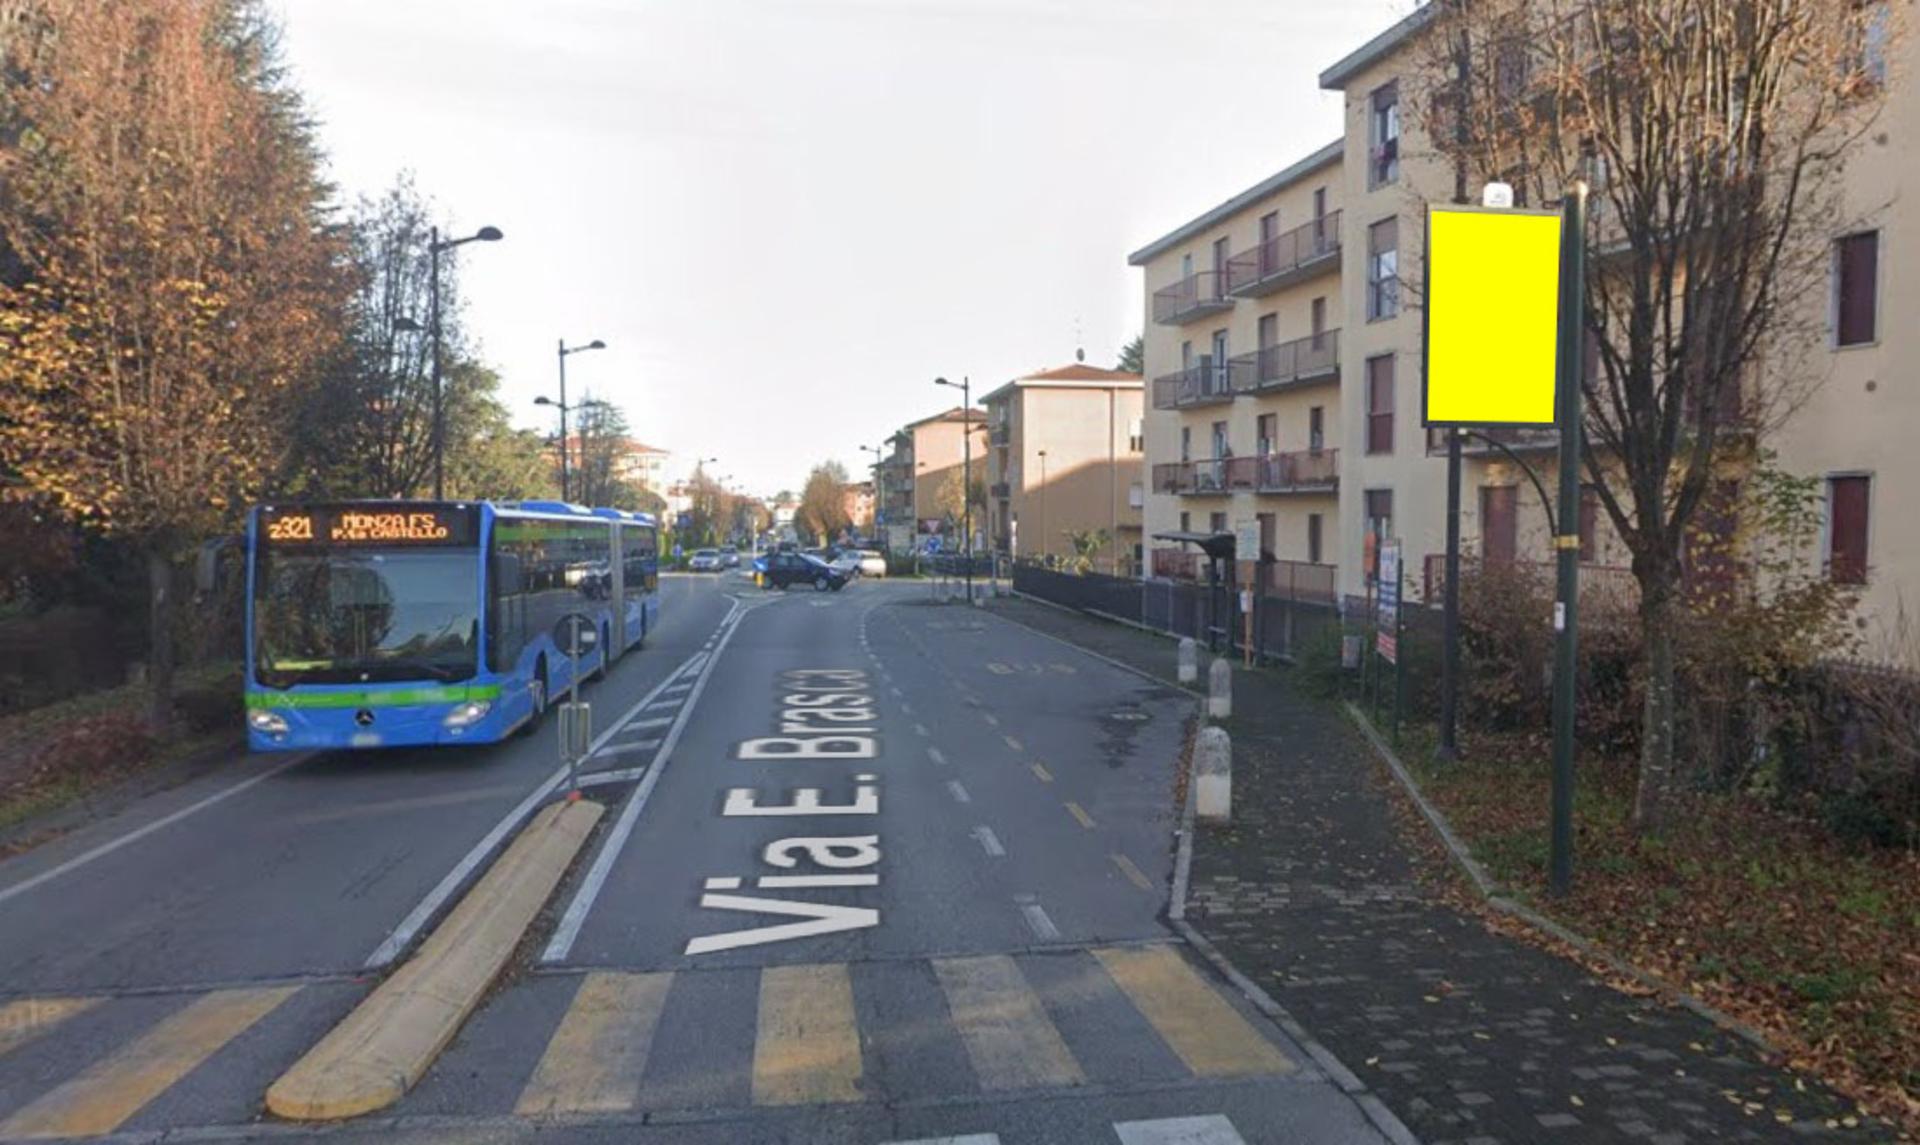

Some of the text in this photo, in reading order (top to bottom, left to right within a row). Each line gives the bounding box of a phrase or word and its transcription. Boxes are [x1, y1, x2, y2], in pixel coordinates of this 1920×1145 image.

[342, 513, 435, 528] MONZA FS
[370, 527, 448, 539] CASTELLO
